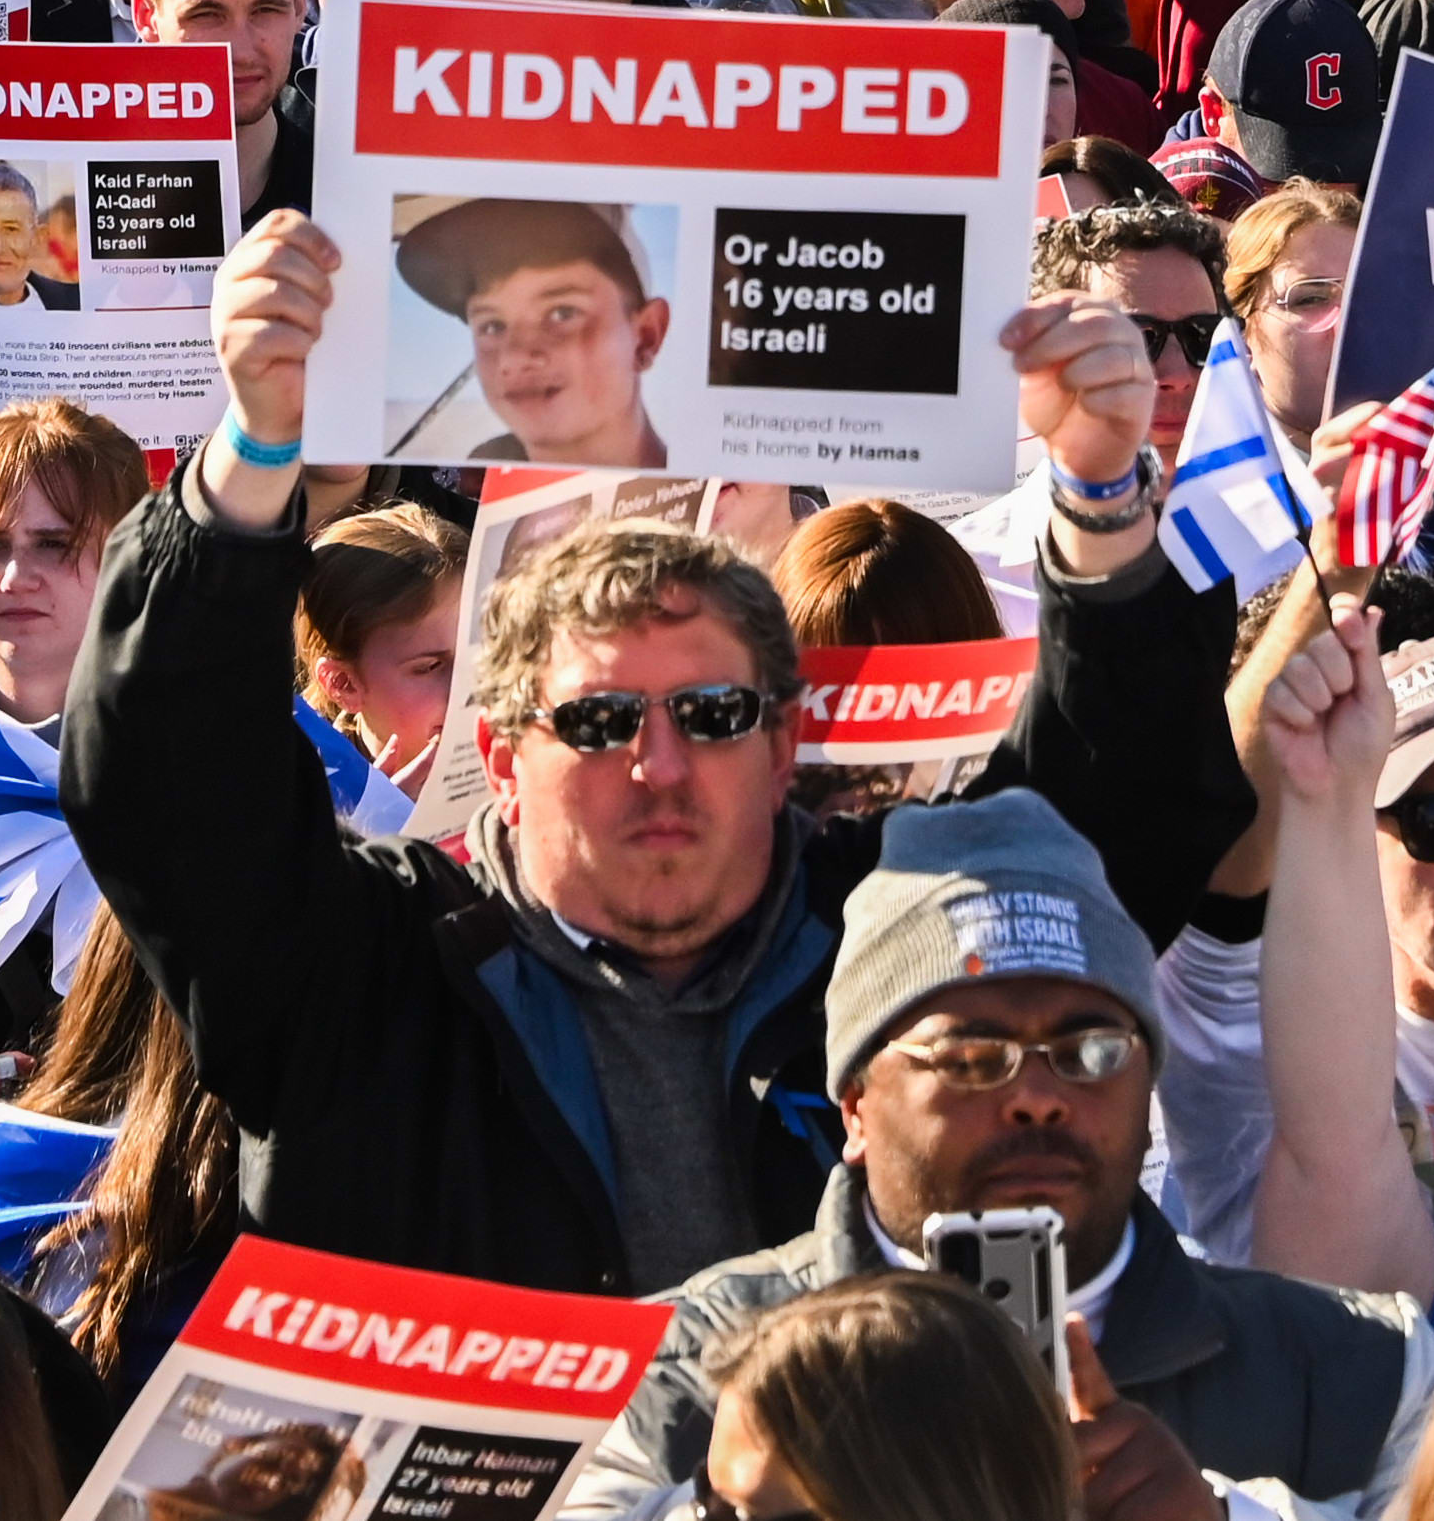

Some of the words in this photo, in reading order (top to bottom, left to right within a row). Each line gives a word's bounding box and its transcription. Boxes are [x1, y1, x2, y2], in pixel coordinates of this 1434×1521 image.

[391, 46, 970, 137] KIDNAPPED
[1304, 51, 1342, 111] C
[94, 173, 130, 192] Kaid
[135, 173, 194, 192] Farhan
[94, 194, 158, 214] Al-Qadi
[96, 234, 149, 252] Israeli
[722, 234, 766, 268] Or
[777, 236, 885, 271] Jacob
[722, 279, 766, 308] 16
[773, 284, 869, 317] years
[878, 282, 934, 315] old
[720, 321, 827, 355] Israeli
[722, 410, 833, 436] Kidnapped
[837, 415, 883, 435] from
[721, 437, 748, 457] his
[754, 440, 812, 459] home
[817, 442, 843, 463] by
[848, 443, 920, 464] Hamas
[1022, 893, 1078, 920] STANDS
[1014, 918, 1082, 947] ISRAEL
[223, 1287, 631, 1395] KIDNAPPED
[412, 1440, 469, 1468] Inbar
[474, 1449, 559, 1475] Haiman
